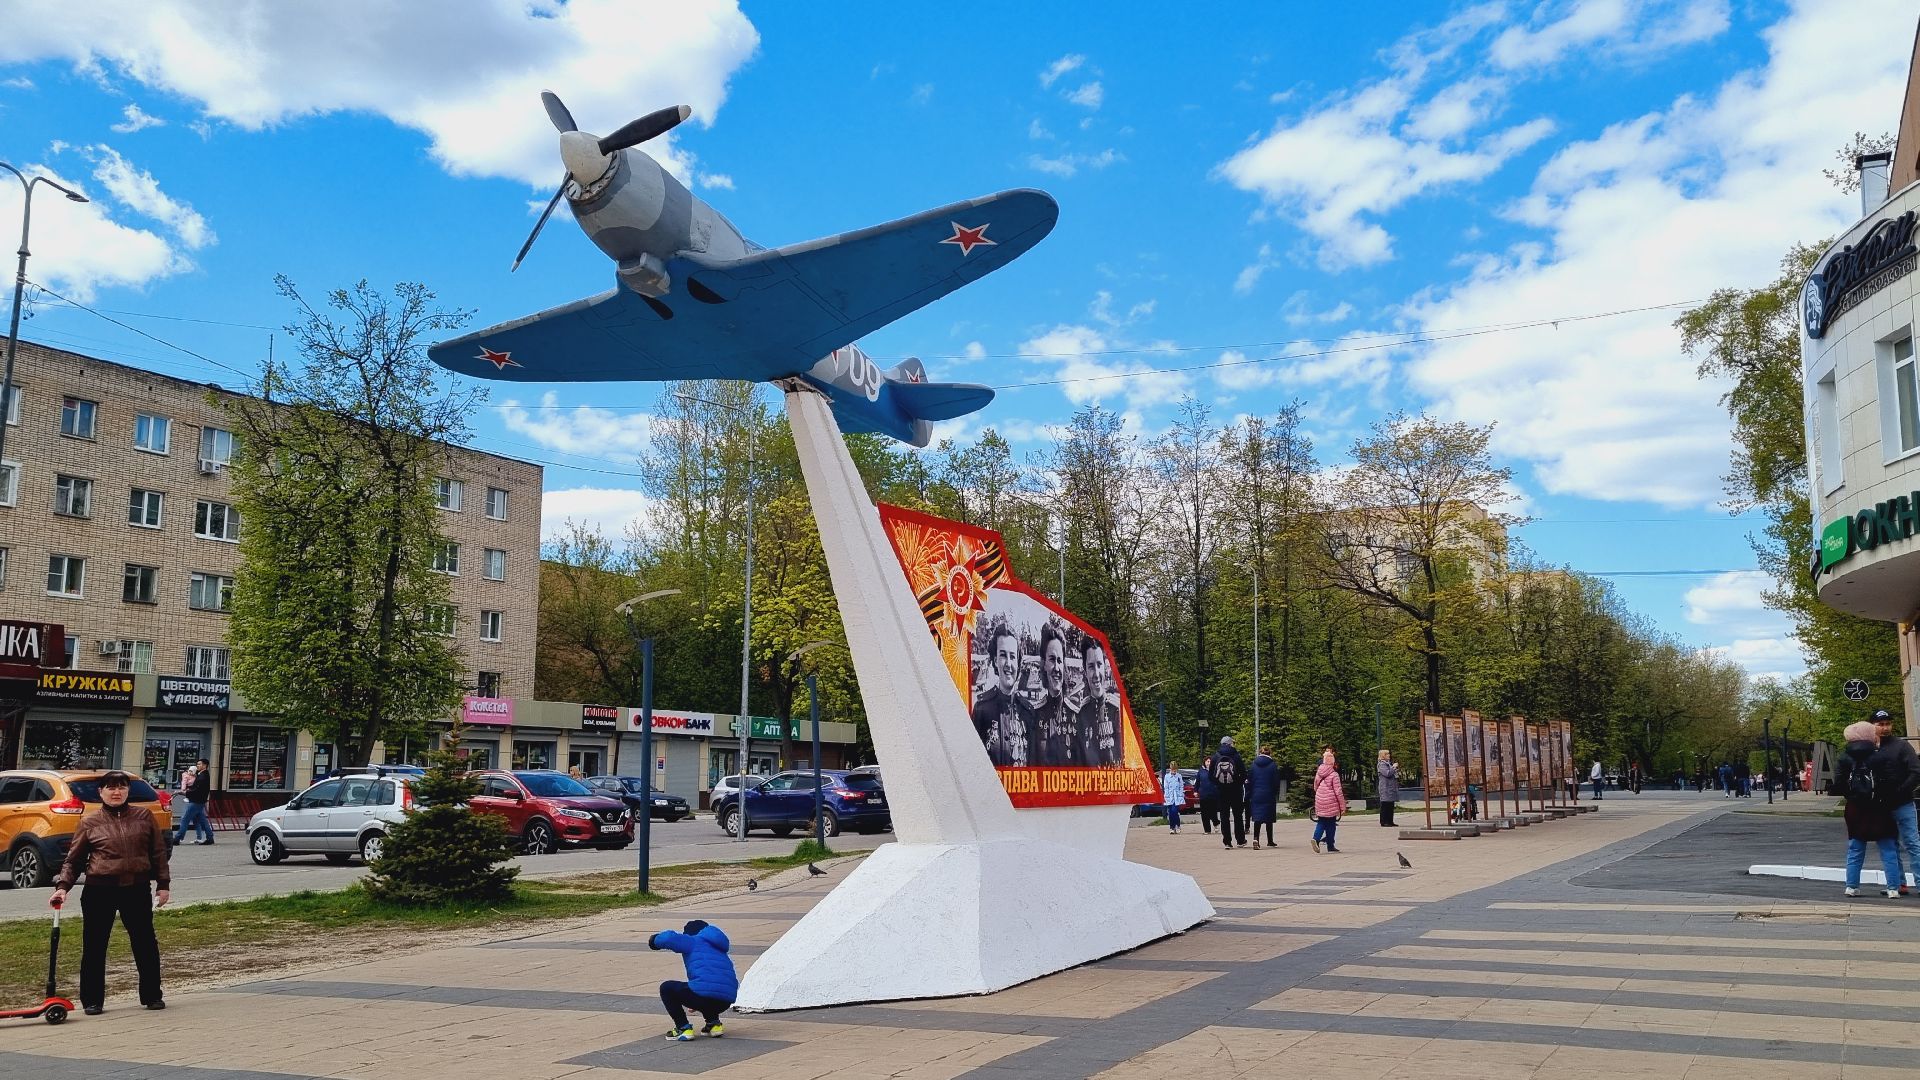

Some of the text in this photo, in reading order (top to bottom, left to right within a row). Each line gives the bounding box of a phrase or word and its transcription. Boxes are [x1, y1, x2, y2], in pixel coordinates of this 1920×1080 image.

[1868, 256, 1917, 293] КРАСОТЫ
[849, 343, 881, 402] 09
[42, 674, 120, 691] КРУЖКА
[160, 680, 230, 693] ЦВЕТОЧНАЯ
[36, 690, 69, 698] АЗЛИВНЫЕ
[174, 694, 216, 705] ЛАВКА
[650, 716, 711, 730] ОВКОМБАНК
[763, 724, 798, 737] АПТА
[1043, 770, 1134, 795] ПОБЕДИТЕЛЯМ!
